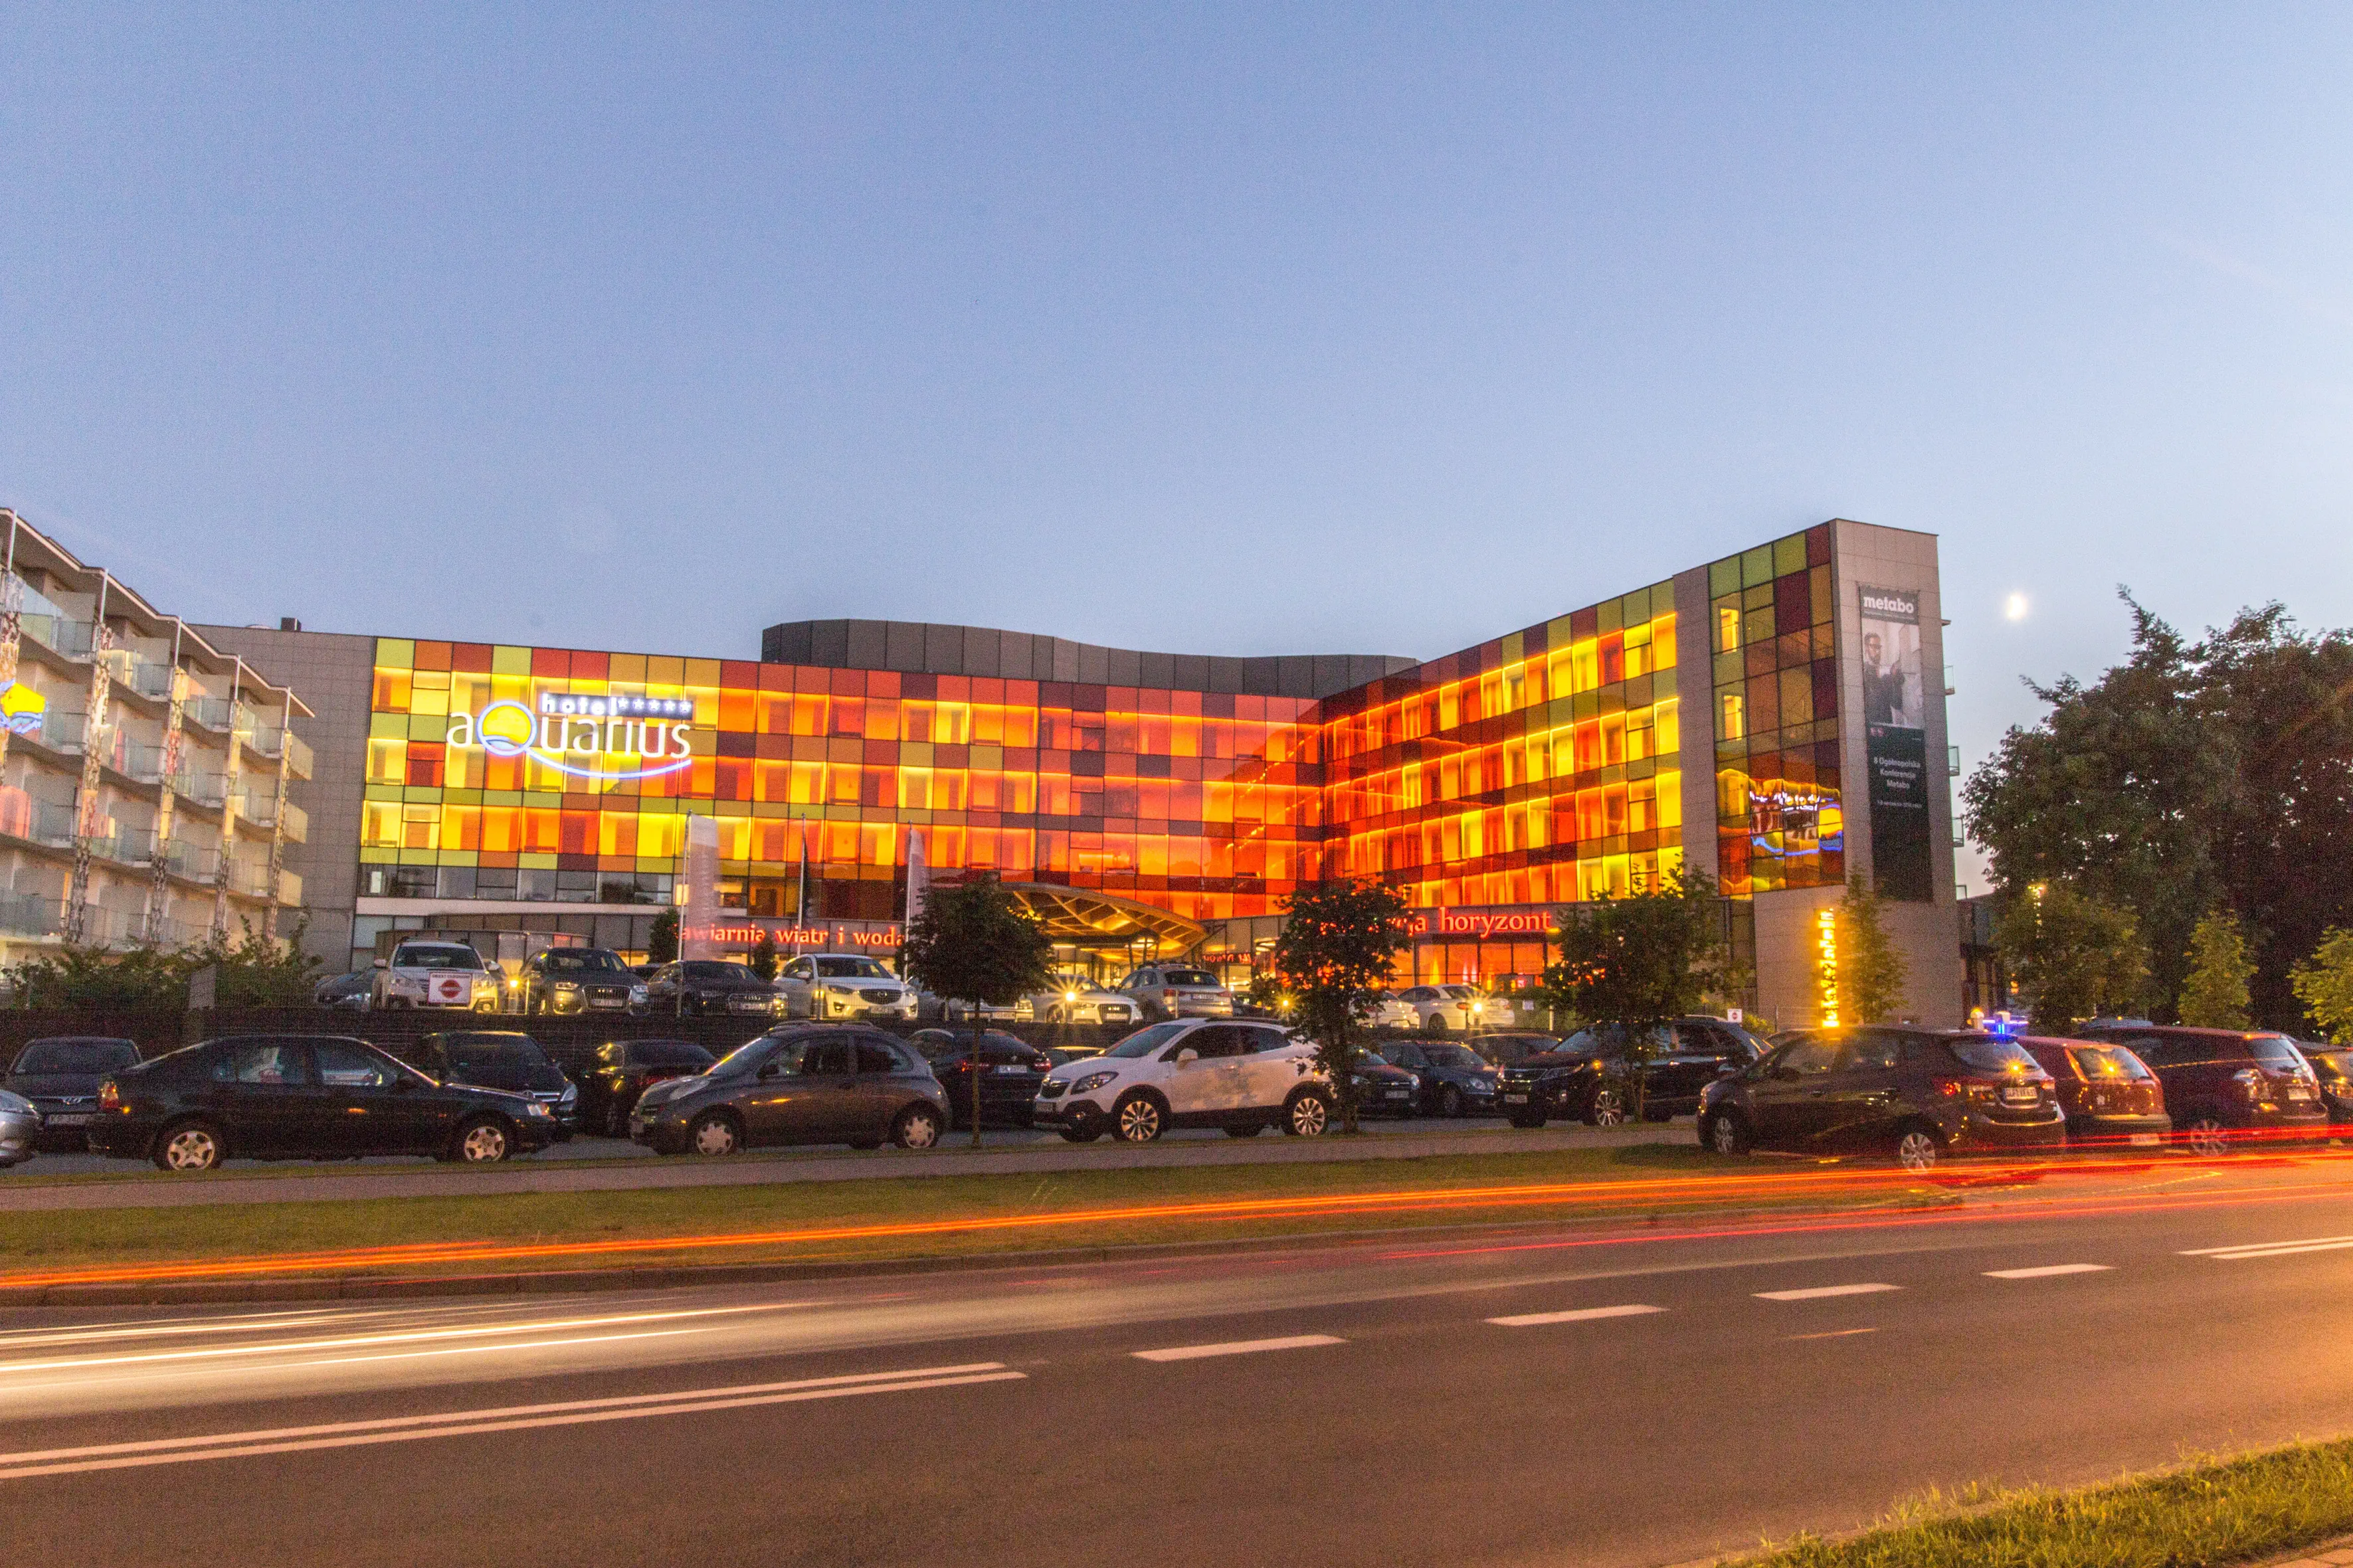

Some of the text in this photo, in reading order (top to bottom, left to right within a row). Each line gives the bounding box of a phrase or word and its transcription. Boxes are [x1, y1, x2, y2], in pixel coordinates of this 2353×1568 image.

[1863, 596, 1915, 614] metabo
[541, 693, 617, 716] hotel
[675, 923, 765, 944] awiarnia
[776, 922, 829, 944] wiatr
[837, 926, 844, 944] i
[1440, 907, 1552, 939] horyzont
